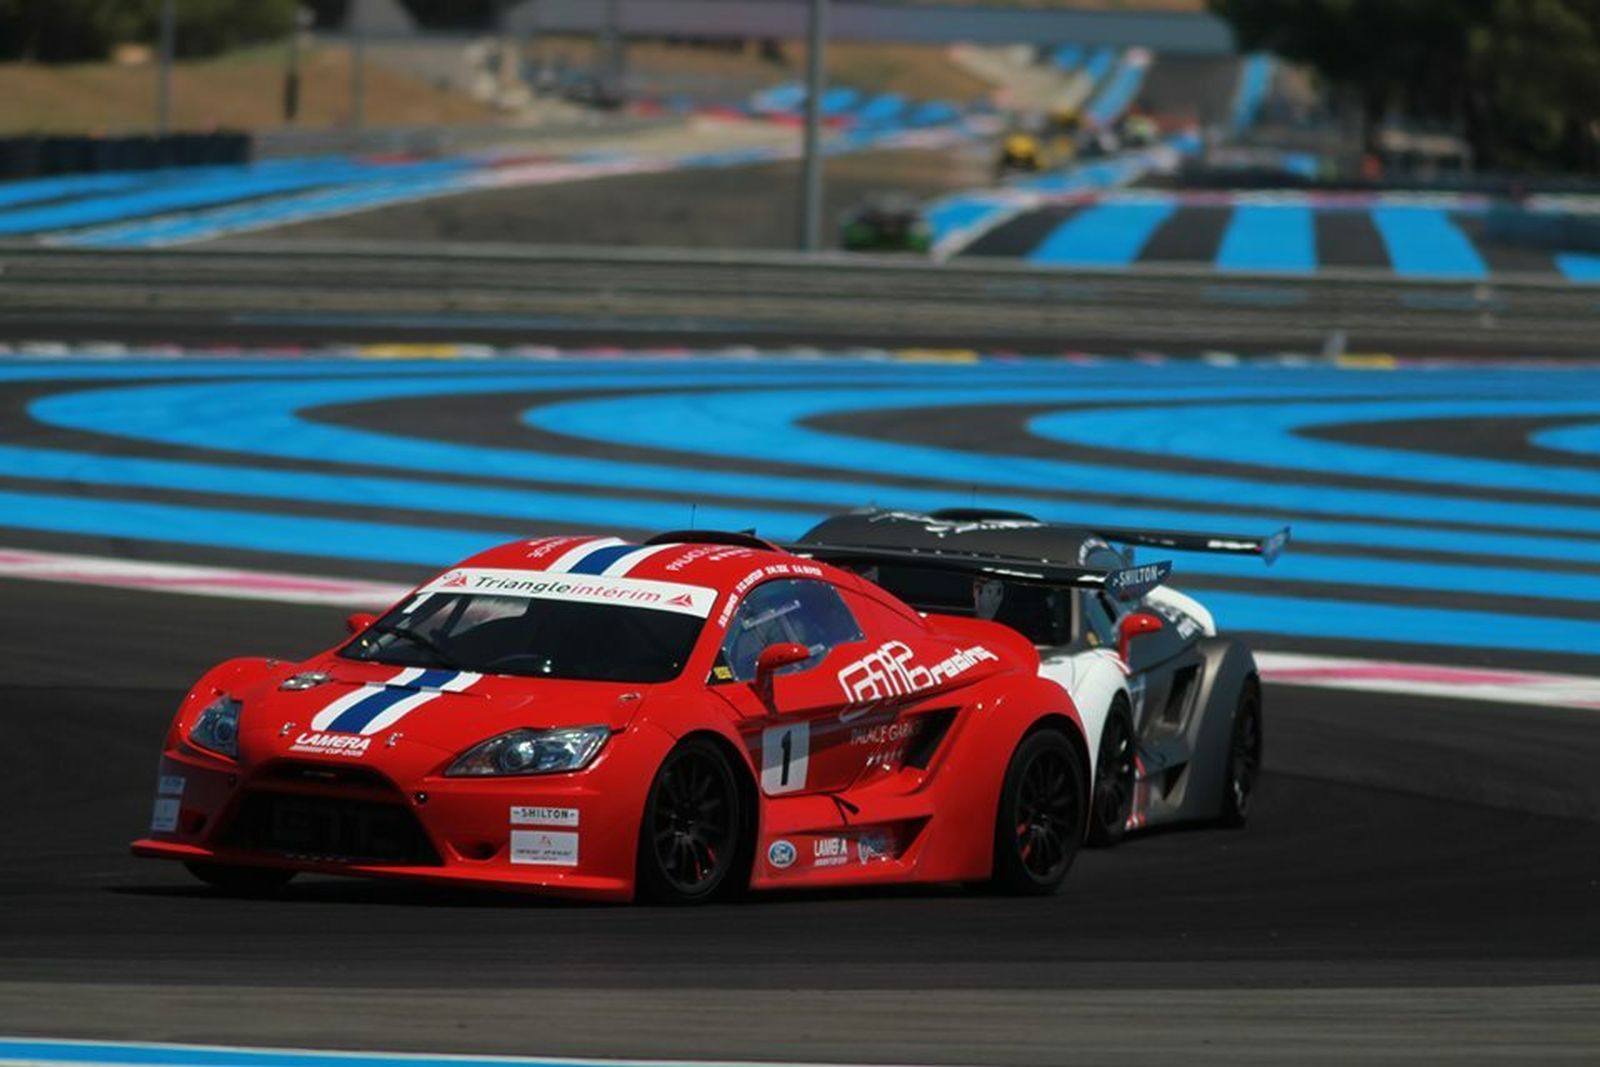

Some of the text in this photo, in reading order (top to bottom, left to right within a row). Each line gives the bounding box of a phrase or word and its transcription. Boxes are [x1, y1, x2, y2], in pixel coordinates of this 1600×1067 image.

[1119, 565, 1159, 587] SHILTON
[295, 732, 372, 750] LAMERA
[780, 730, 793, 787] 1
[521, 808, 569, 819] SHILTON
